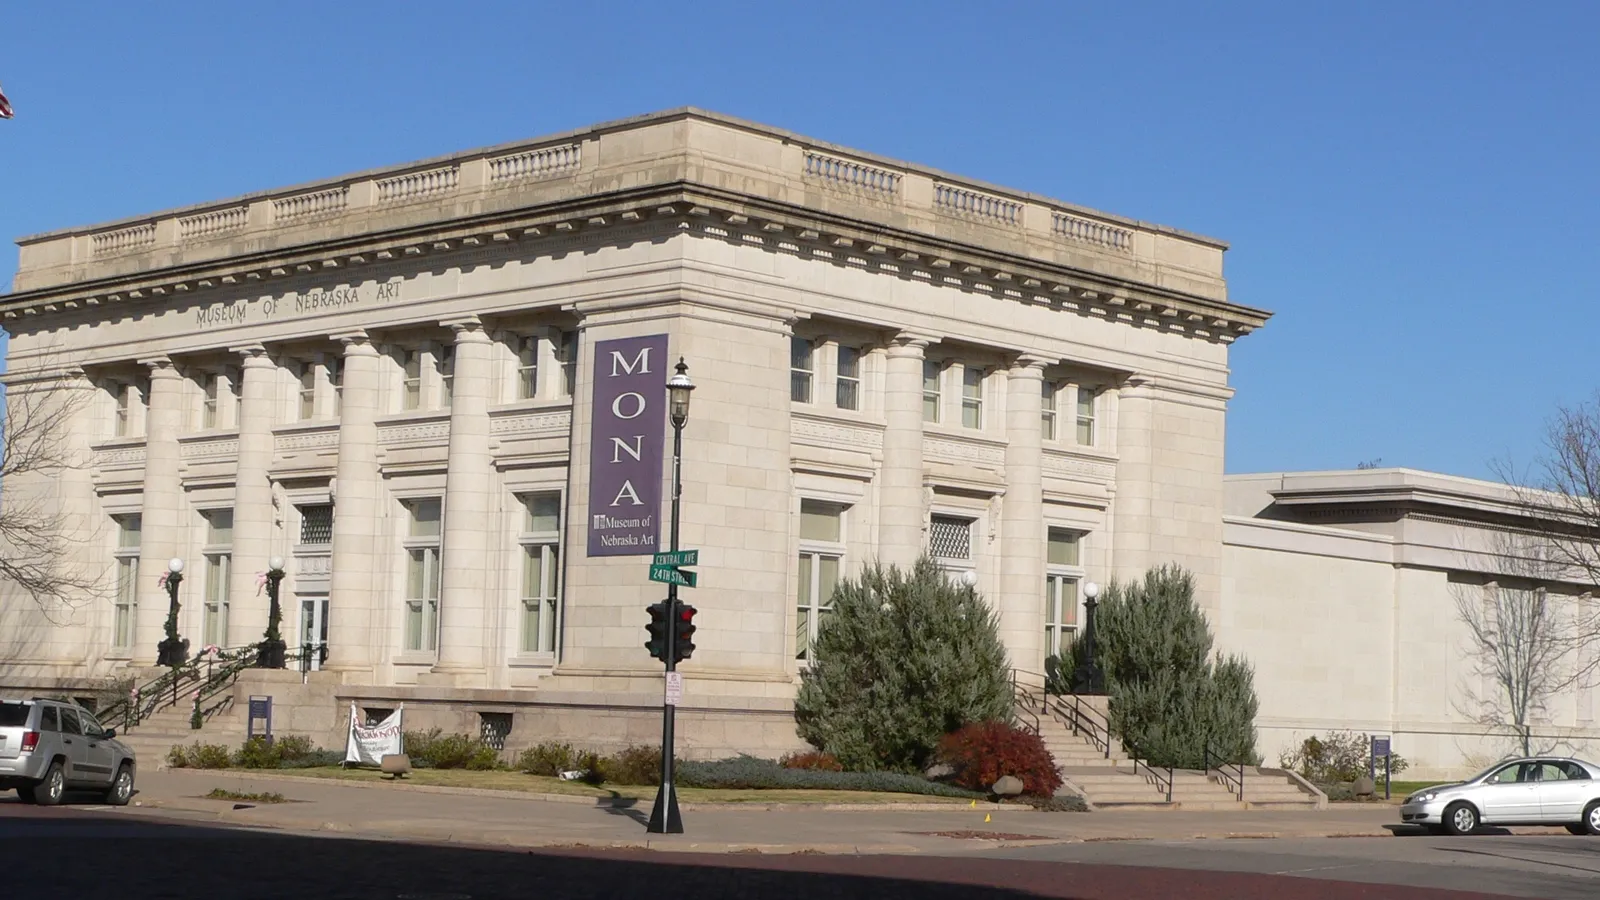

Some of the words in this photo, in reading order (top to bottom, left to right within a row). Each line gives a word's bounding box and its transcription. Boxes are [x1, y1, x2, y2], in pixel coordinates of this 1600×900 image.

[196, 303, 247, 324] MUSEUM
[263, 299, 279, 315] OF
[295, 288, 359, 312] NEBRASKA
[376, 281, 401, 300] ART
[606, 517, 640, 529] Museum
[641, 515, 652, 527] of
[601, 534, 638, 546] Nebraska
[640, 534, 654, 545] Art
[655, 554, 681, 566] CENTRAL
[683, 552, 696, 564] AVE
[653, 568, 671, 581] 24TH
